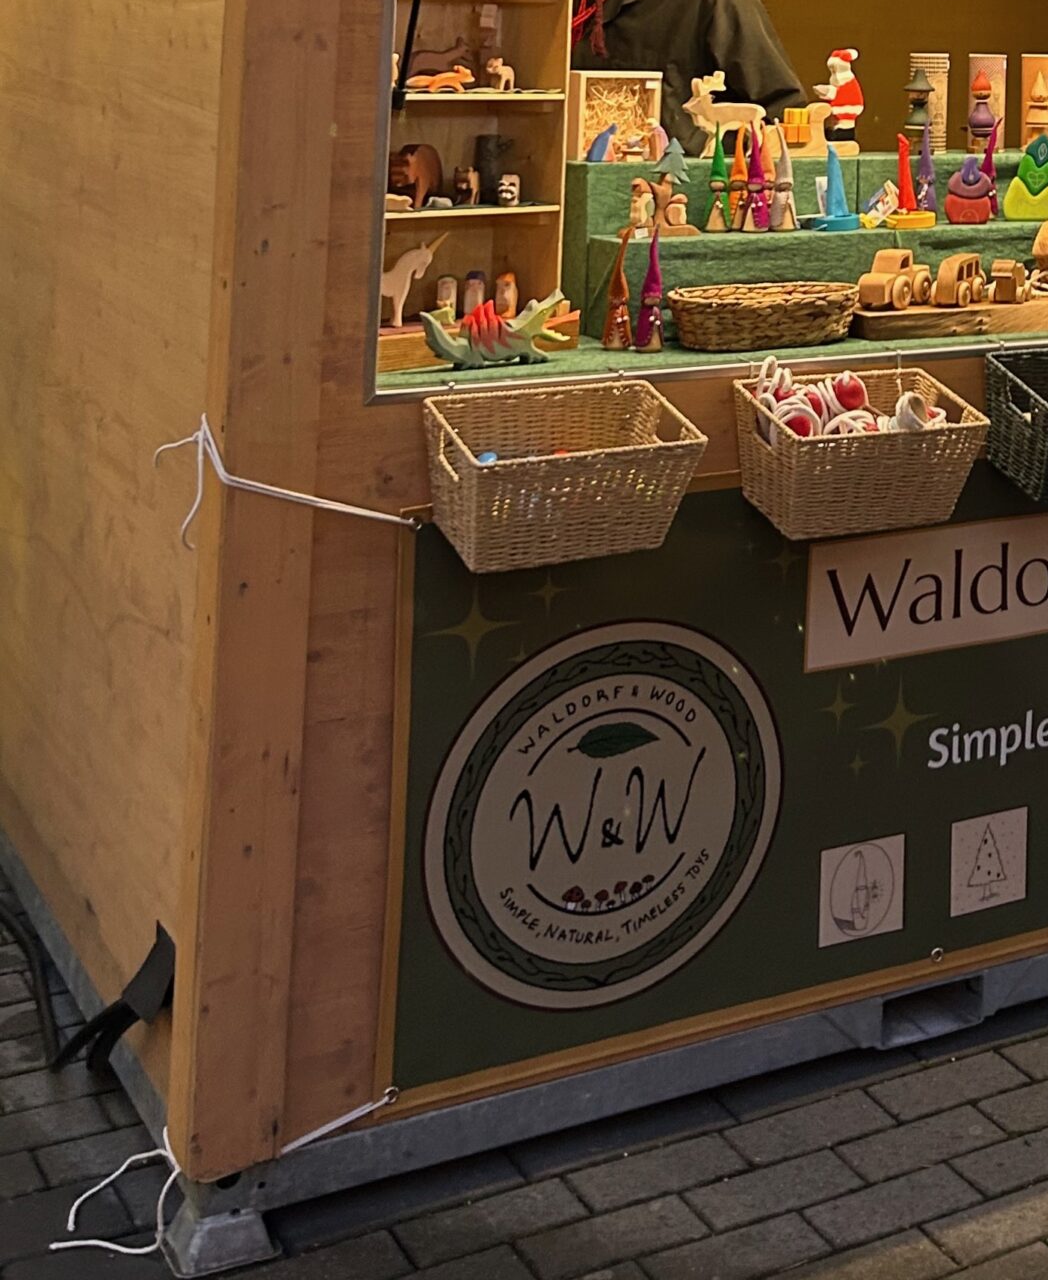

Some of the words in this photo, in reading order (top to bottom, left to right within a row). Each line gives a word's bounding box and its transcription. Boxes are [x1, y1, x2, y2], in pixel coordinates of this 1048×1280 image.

[518, 685, 624, 755] WALDORF
[650, 685, 697, 722] WOOD
[620, 881, 686, 935] TIMELESS
[685, 847, 710, 880] TOYS
